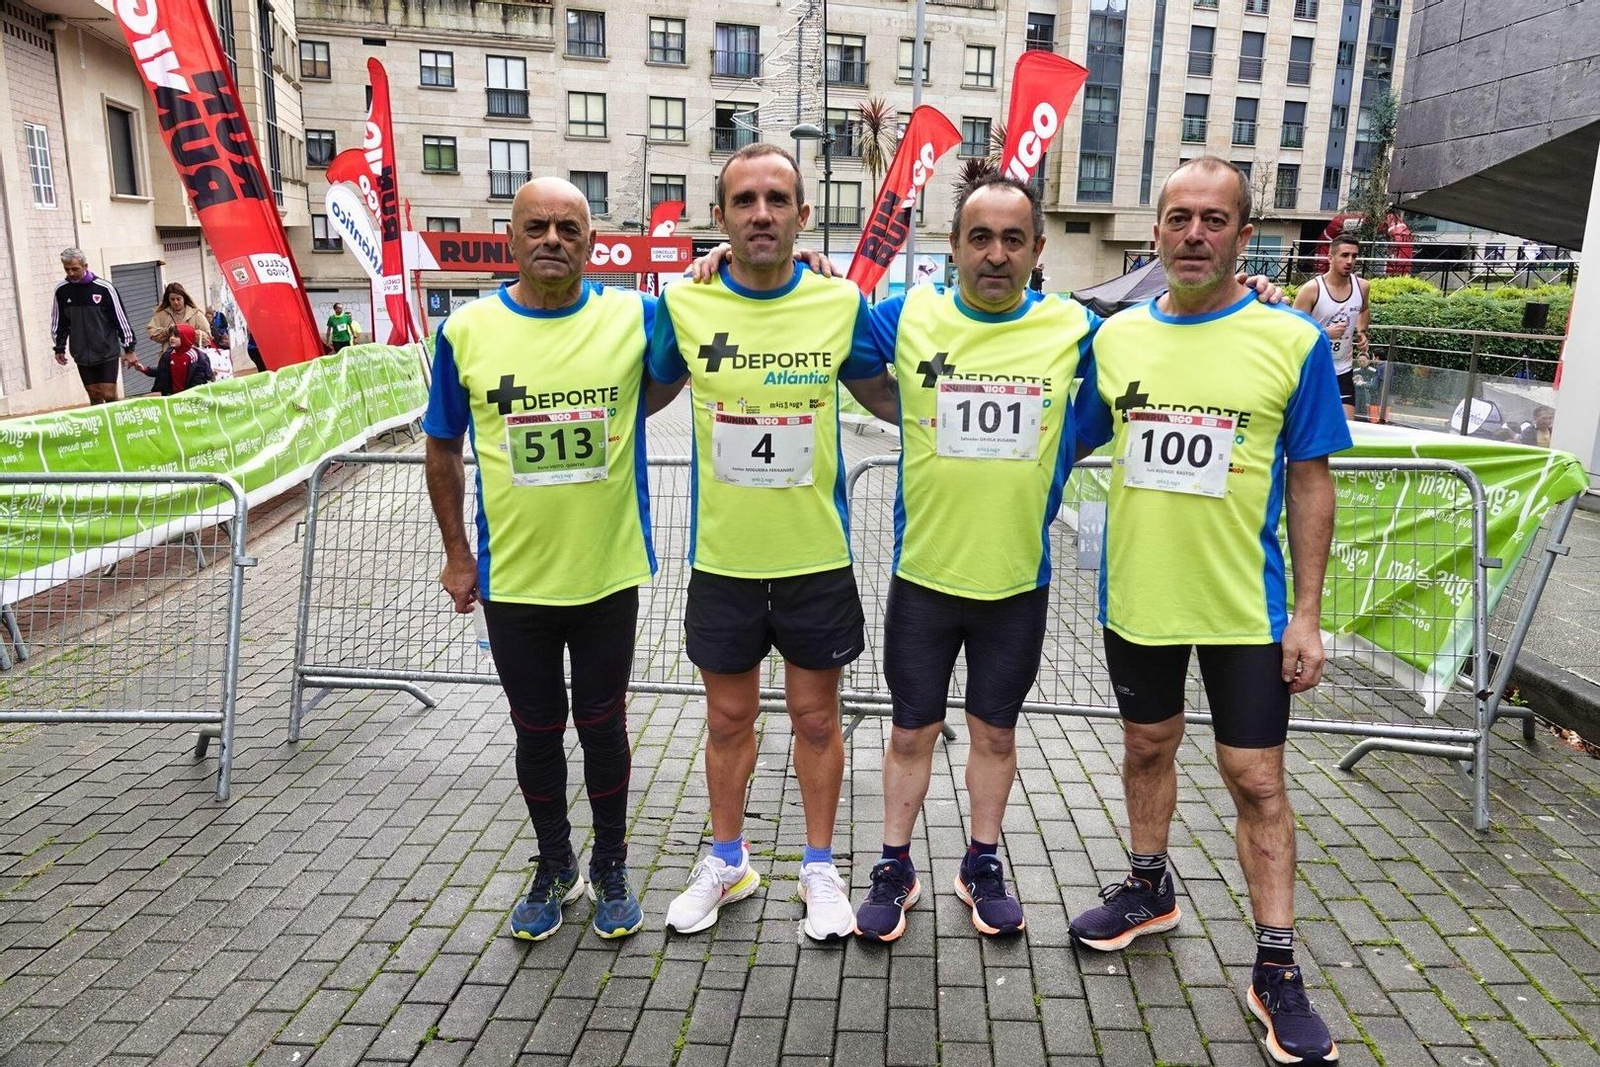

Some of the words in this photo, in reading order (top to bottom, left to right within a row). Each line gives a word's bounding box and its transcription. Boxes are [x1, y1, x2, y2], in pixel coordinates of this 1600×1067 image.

[732, 352, 831, 370] DEPORTE
[763, 370, 830, 386] Atlántico
[523, 386, 618, 410] DEPORTE
[956, 399, 1021, 435] 101
[525, 427, 594, 464] 513
[751, 433, 775, 464] 4
[1141, 429, 1213, 469] 100
